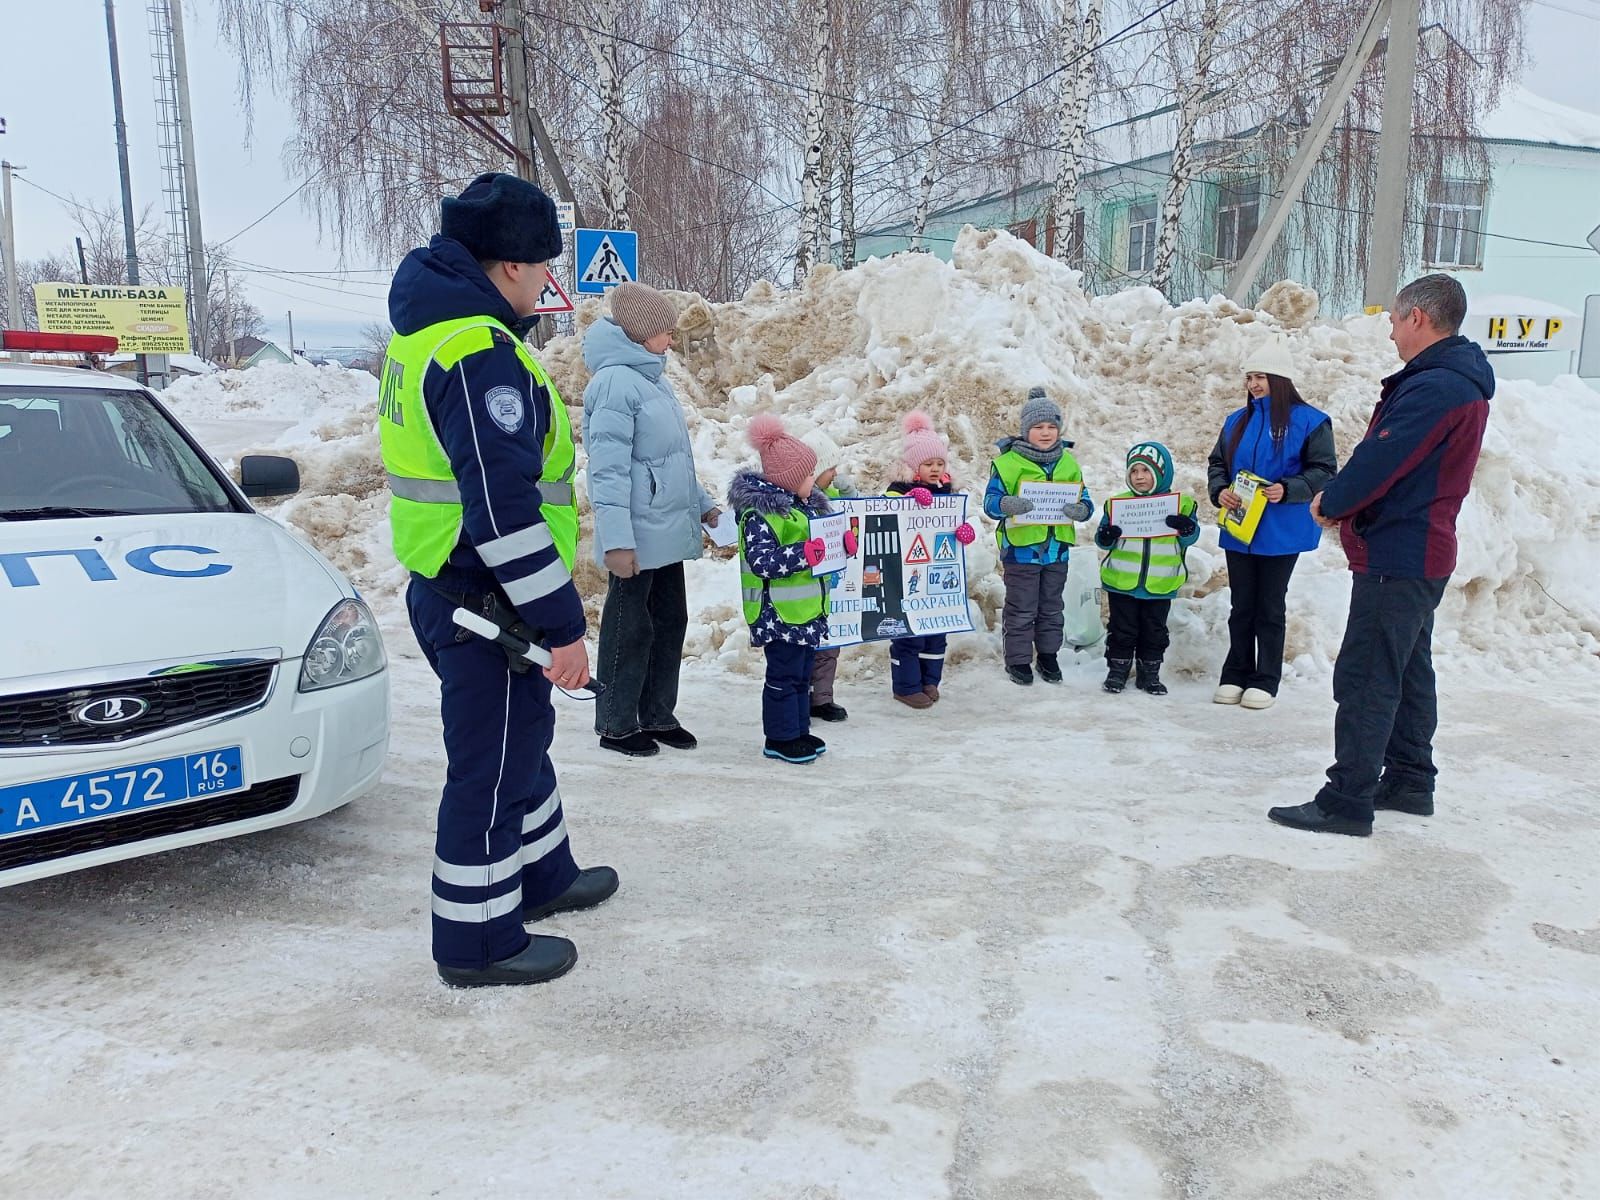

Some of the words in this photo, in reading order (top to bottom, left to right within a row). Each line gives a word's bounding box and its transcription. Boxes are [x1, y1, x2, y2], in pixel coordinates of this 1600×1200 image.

[57, 288, 168, 300] МЕТАЛЛ-БАЗА
[865, 496, 958, 512] БЕЗОПАНЫЕ
[906, 514, 958, 532] ДОРОГИ
[928, 572, 941, 585] 02
[916, 613, 968, 631] ЖИЗНЬ!
[15, 797, 41, 827] А
[60, 767, 166, 815] 4572
[192, 752, 229, 781] 16
[197, 778, 226, 793] RUS
